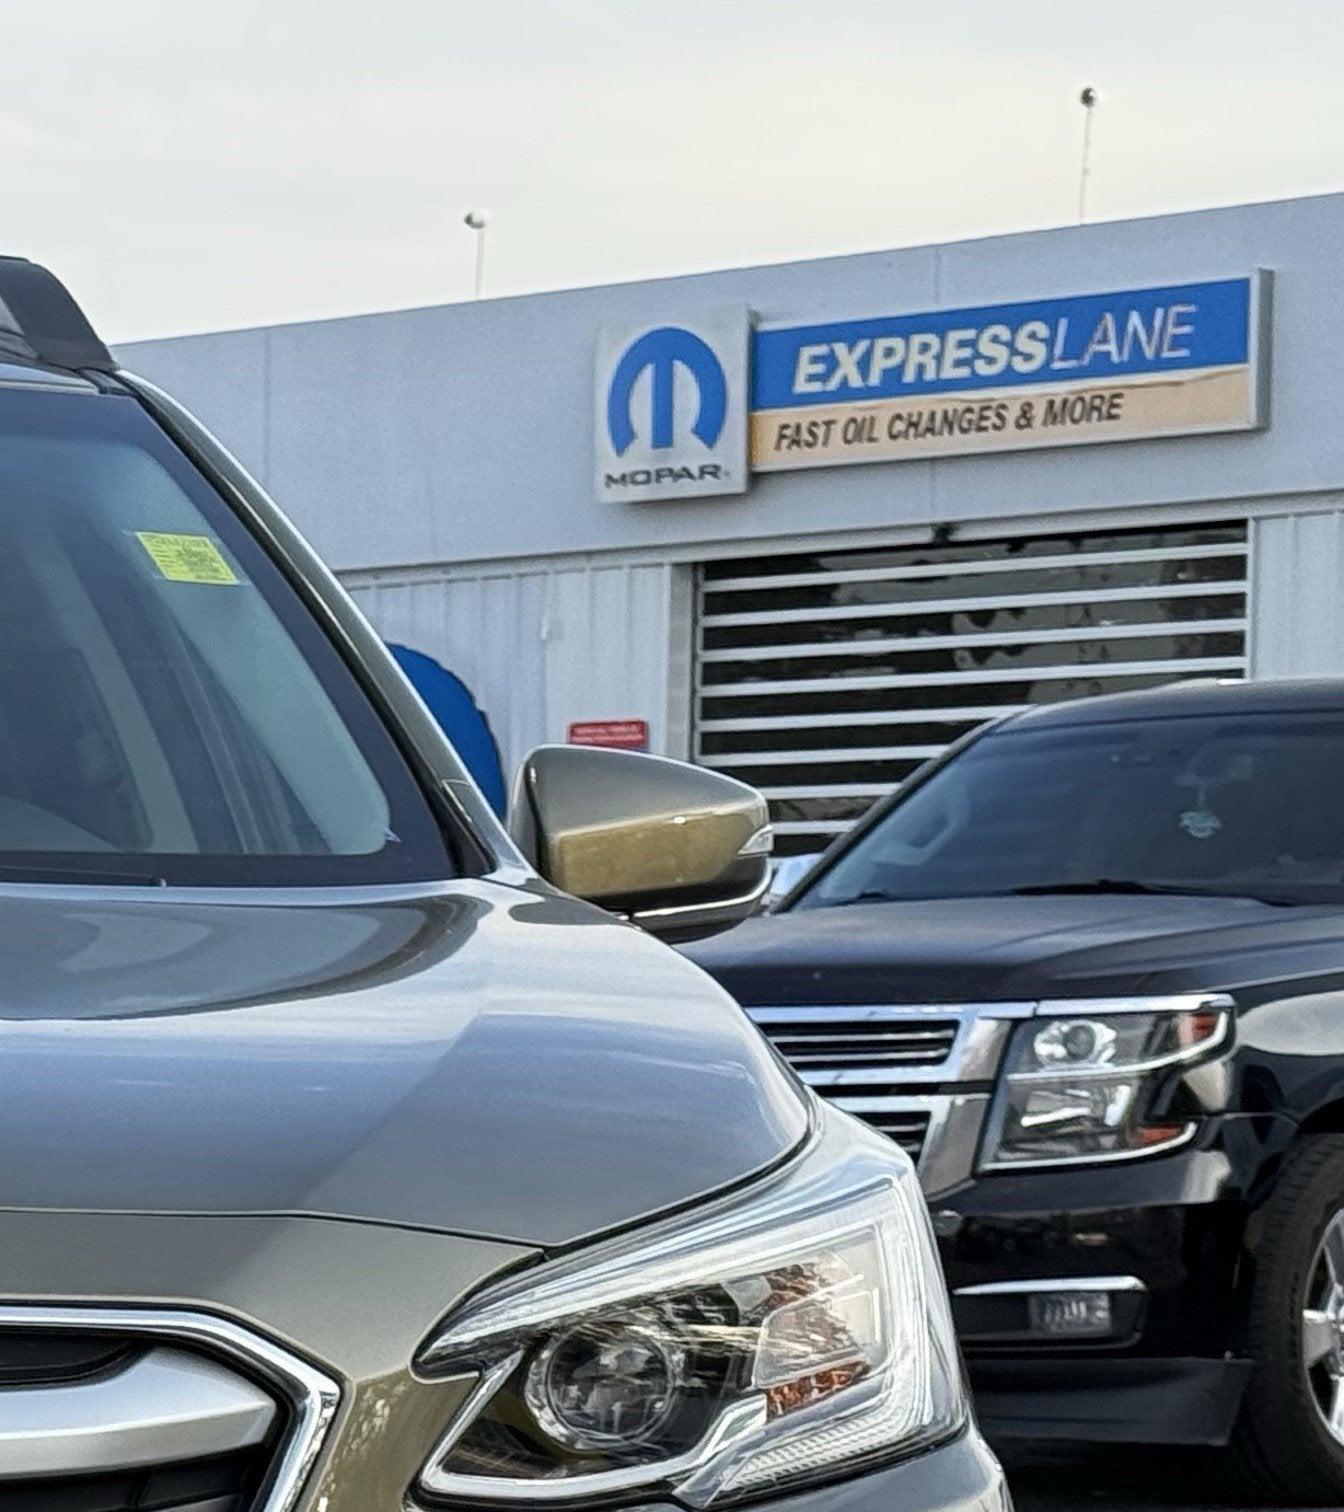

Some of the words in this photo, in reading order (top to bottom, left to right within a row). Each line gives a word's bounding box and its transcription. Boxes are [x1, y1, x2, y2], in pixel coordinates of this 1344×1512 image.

[773, 418, 838, 452] FAST
[842, 415, 878, 446] OIL
[887, 402, 1008, 441] CHANGES
[1014, 400, 1034, 431] &
[1042, 392, 1125, 428] MORE
[605, 463, 722, 489] MOPAR
